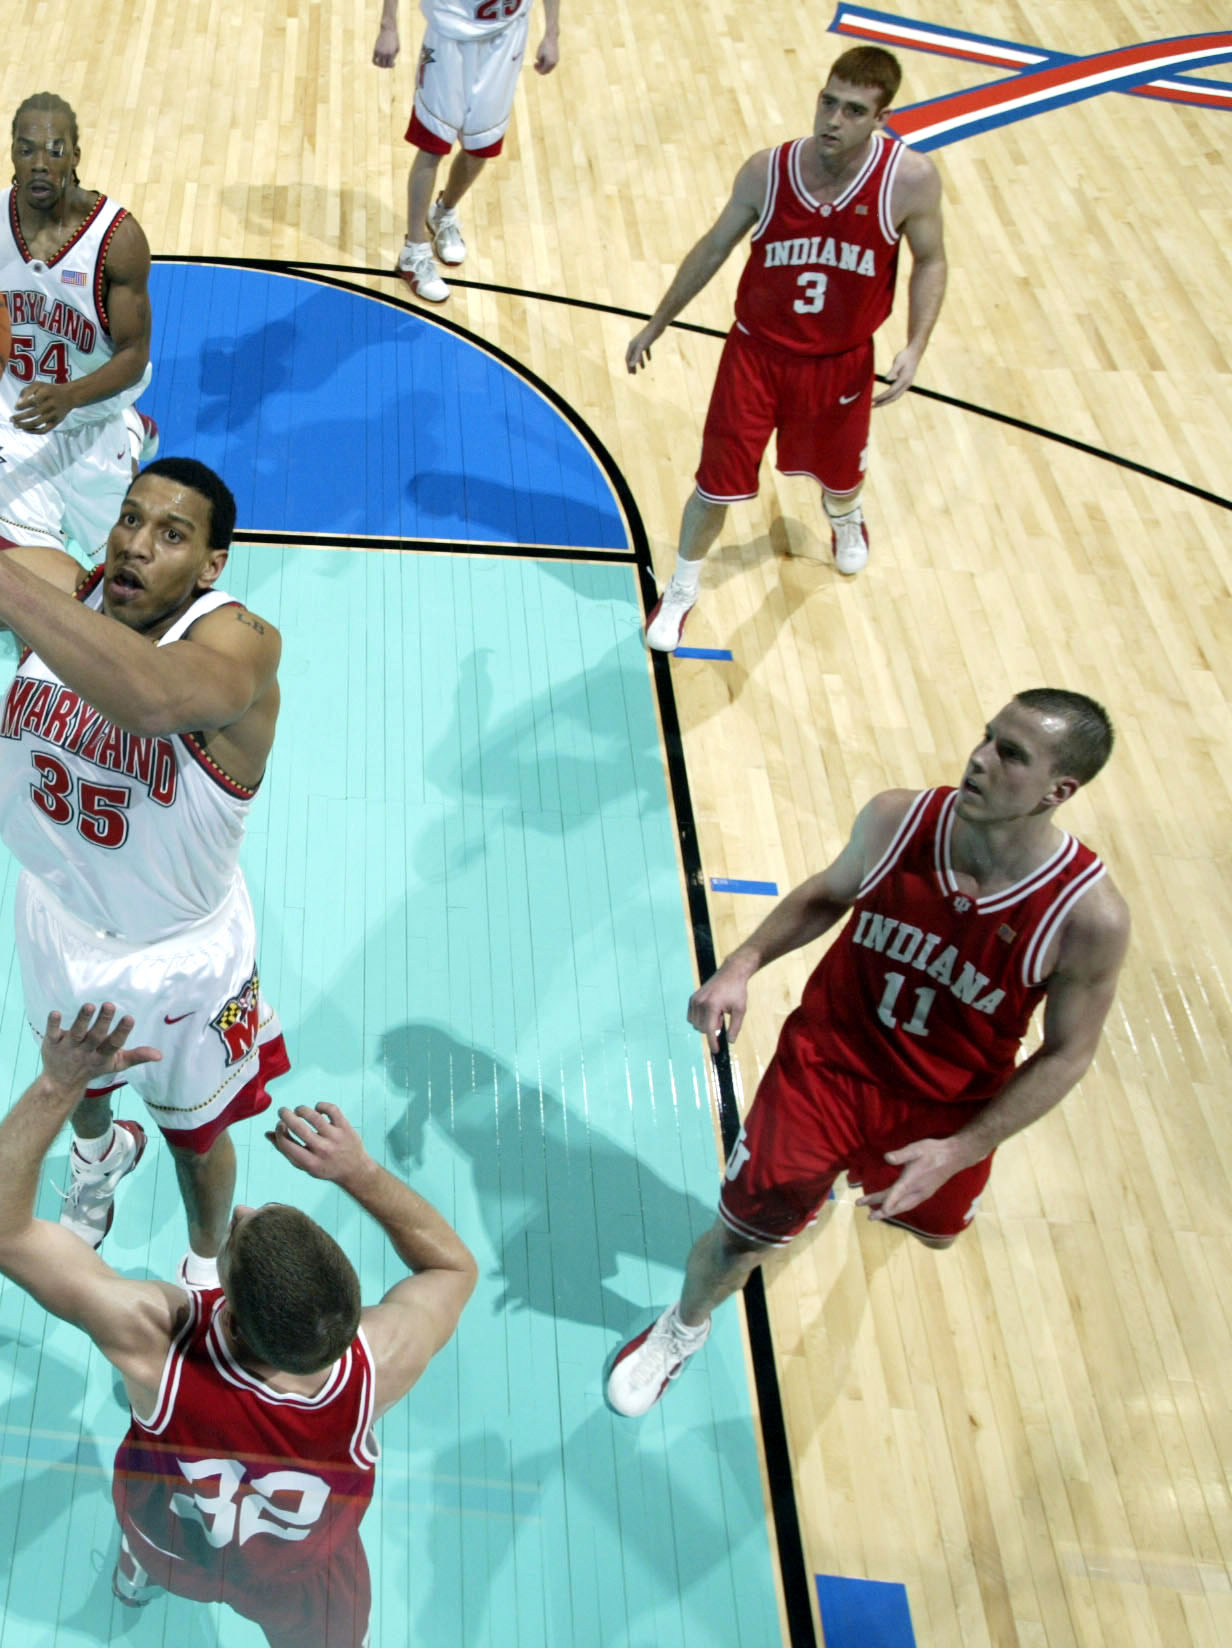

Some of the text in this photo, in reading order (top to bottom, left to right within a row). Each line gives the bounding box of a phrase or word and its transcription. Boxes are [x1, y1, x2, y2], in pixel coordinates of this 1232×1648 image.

[763, 236, 876, 277] INDIANA
[0, 290, 97, 355] RYLAND
[793, 271, 828, 314] 3
[8, 335, 72, 384] 54
[0, 676, 179, 808] MARYLAND
[29, 750, 131, 850] 35
[852, 911, 1007, 1015] INDIANA
[876, 971, 937, 1037] 11
[169, 1457, 331, 1548] 32
